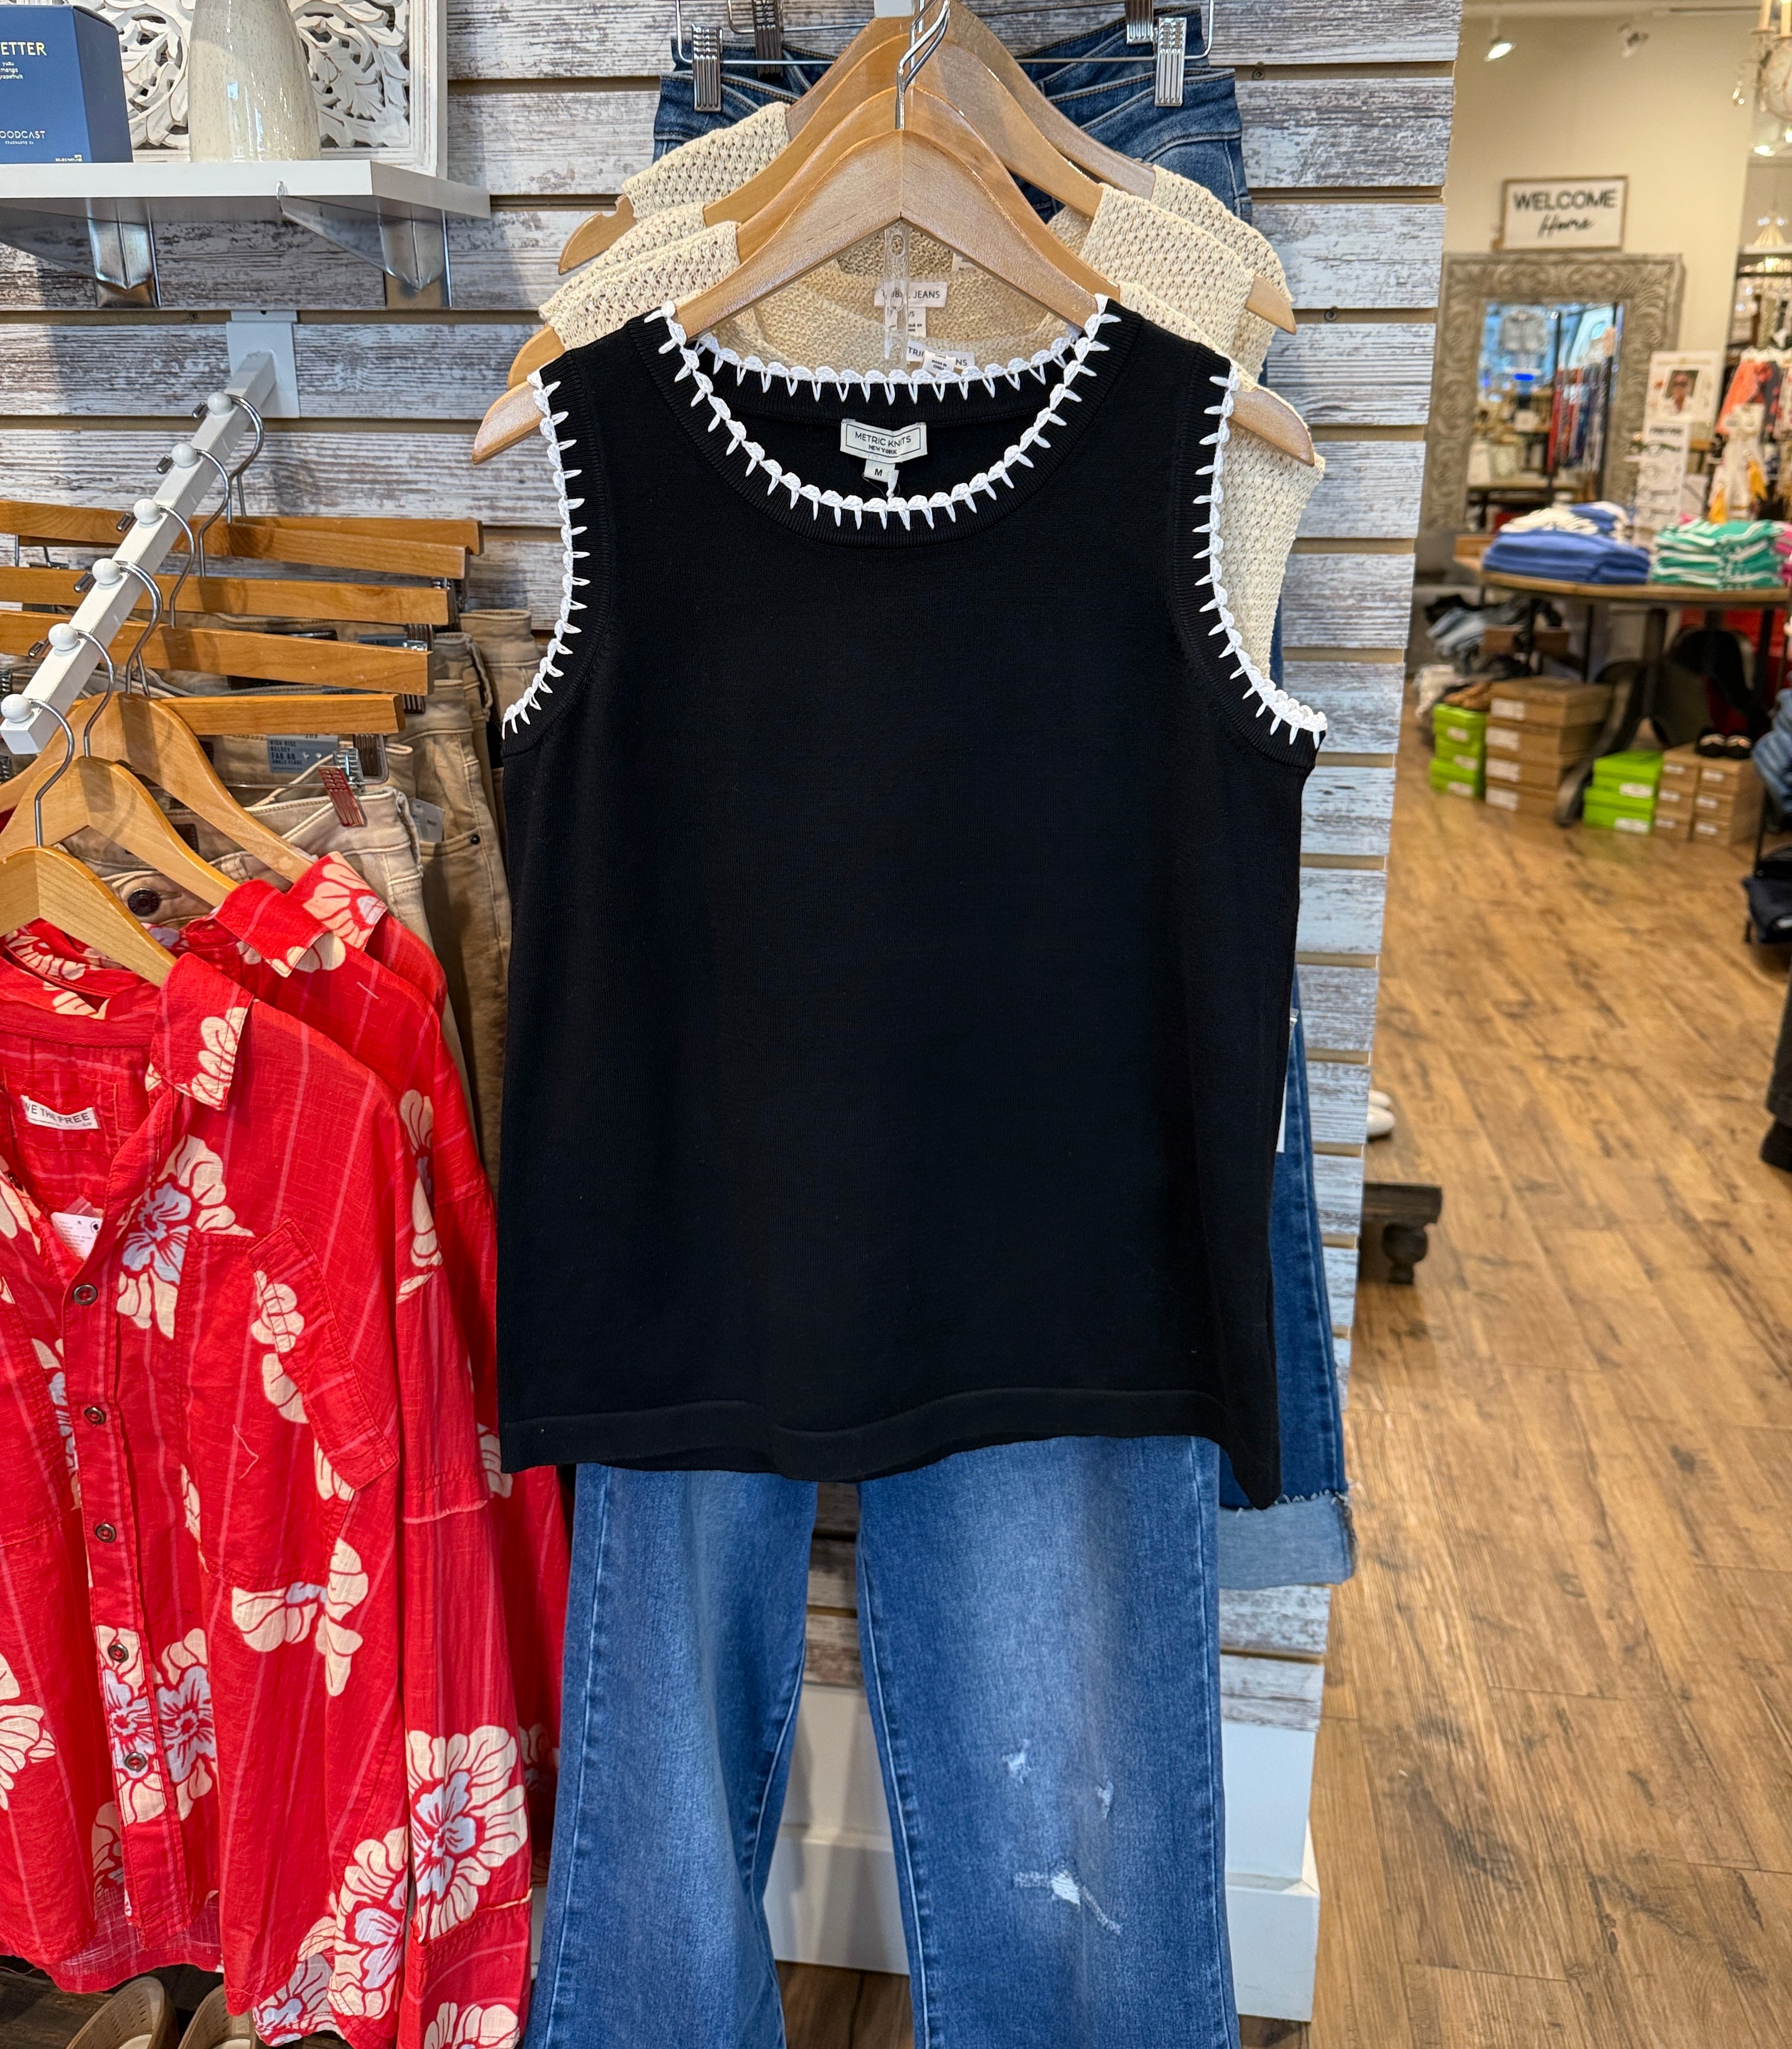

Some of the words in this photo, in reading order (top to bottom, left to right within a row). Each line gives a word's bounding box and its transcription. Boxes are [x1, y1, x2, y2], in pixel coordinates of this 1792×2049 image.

[0, 42, 47, 56] ETTER
[0, 130, 46, 139] OODCAST
[1513, 189, 1618, 211] WELCOME
[1537, 213, 1595, 238] Home
[913, 290, 940, 299] JEANS
[855, 431, 886, 446] METRIC
[888, 435, 912, 448] KNITS
[874, 468, 883, 477] M
[40, 1108, 57, 1121] THE
[58, 1112, 90, 1124] FREE
